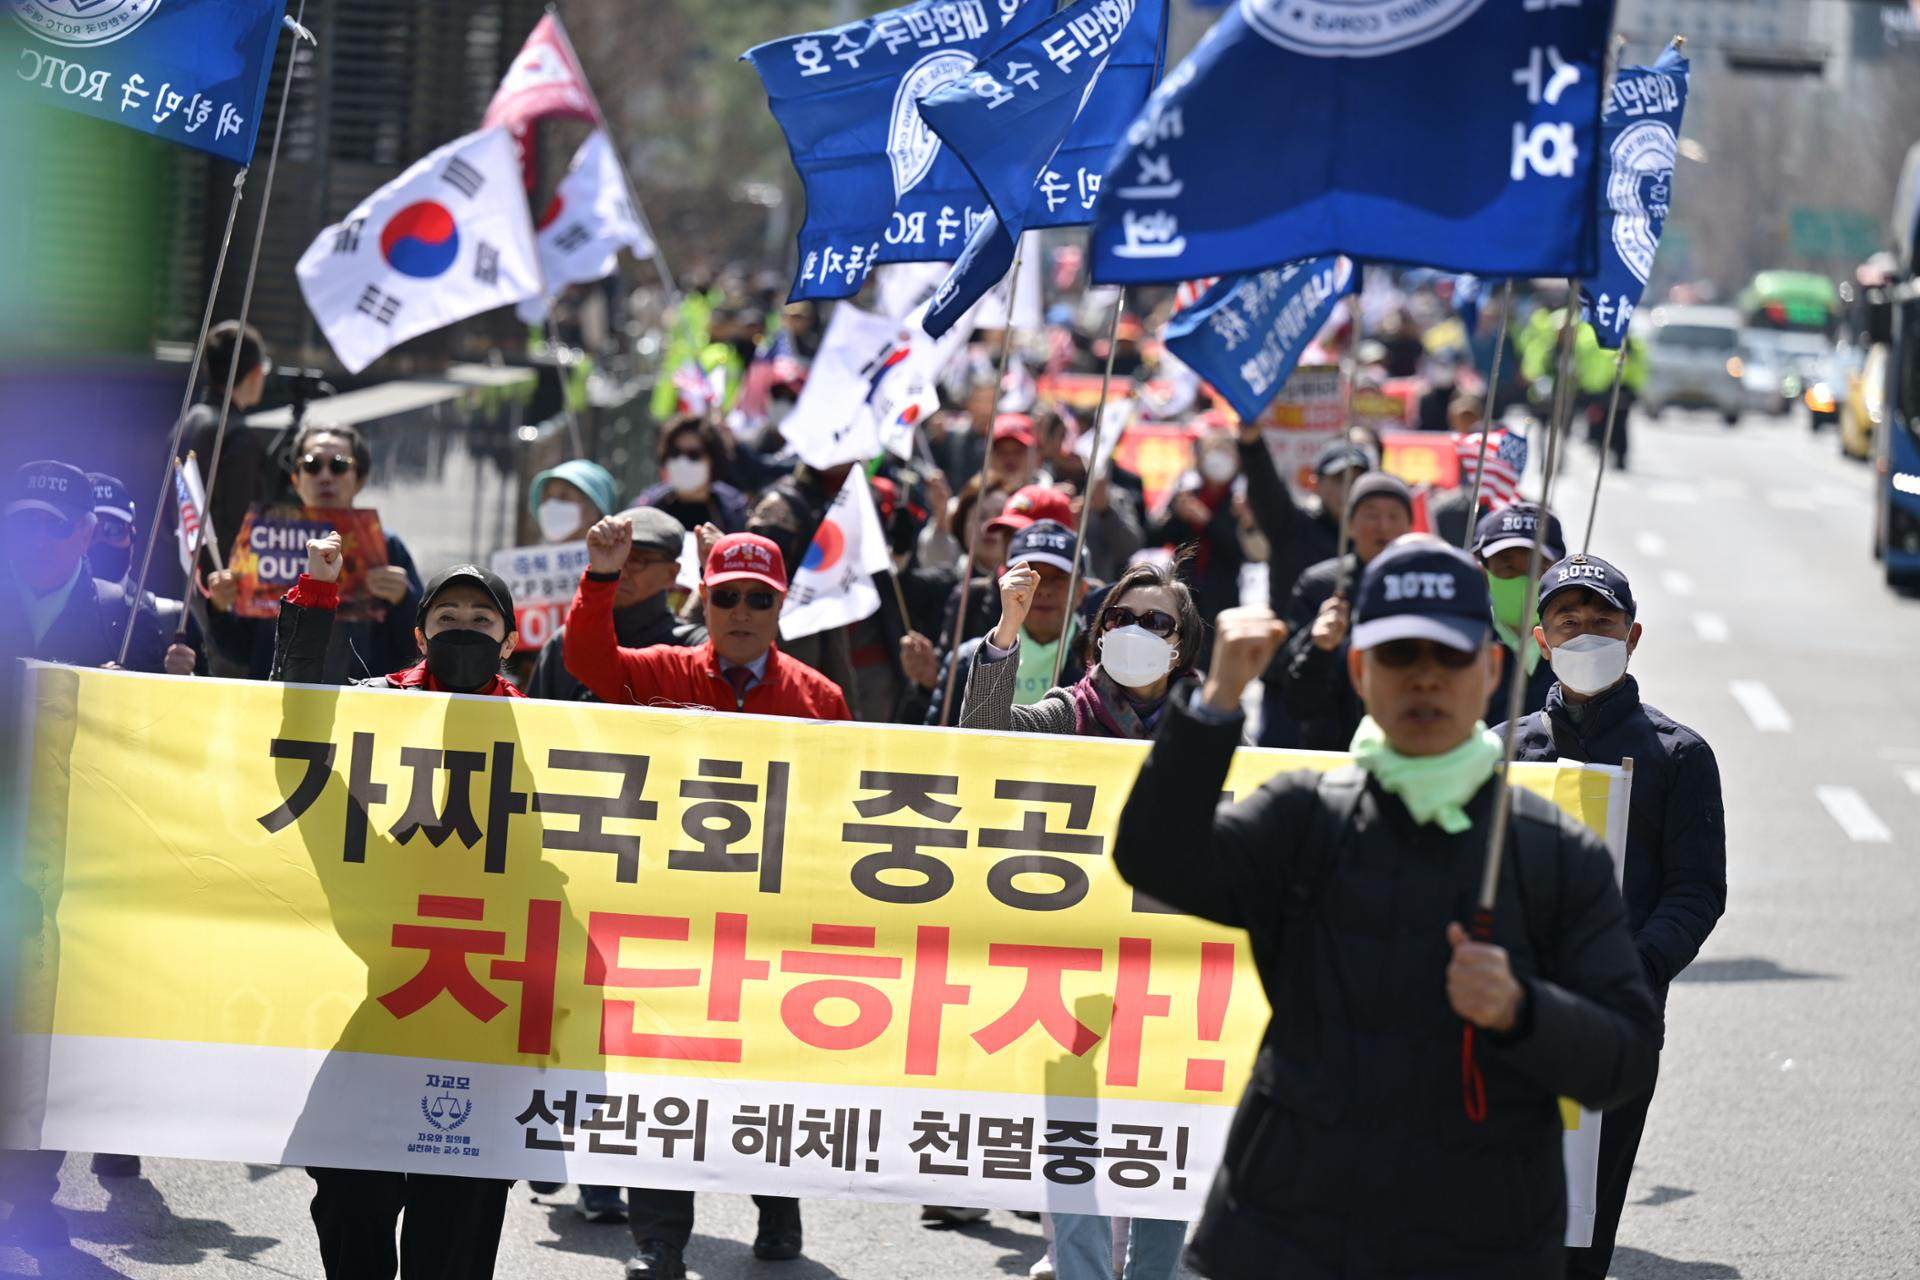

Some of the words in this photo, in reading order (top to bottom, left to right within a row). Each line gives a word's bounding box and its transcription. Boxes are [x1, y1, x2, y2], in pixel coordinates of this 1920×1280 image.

[1511, 46, 1580, 181] 수호
[27, 475, 68, 492] ROTC
[89, 485, 113, 498] TC
[1026, 533, 1066, 549] ROTC
[1558, 565, 1604, 581] ROTC
[1384, 574, 1455, 600] ROTC
[257, 731, 790, 894] 가짜국회
[377, 894, 1235, 1092] 처단하자!
[426, 1074, 470, 1090] 자교모
[418, 1132, 443, 1143] 자유와
[445, 1134, 471, 1144] 정의를
[515, 1089, 707, 1161] 선관위
[732, 1103, 881, 1172] 해체!
[908, 1110, 1189, 1191] 천멸중공!
[407, 1143, 441, 1154] 실천하는
[443, 1145, 460, 1155] 교수
[462, 1147, 480, 1157] 모임
